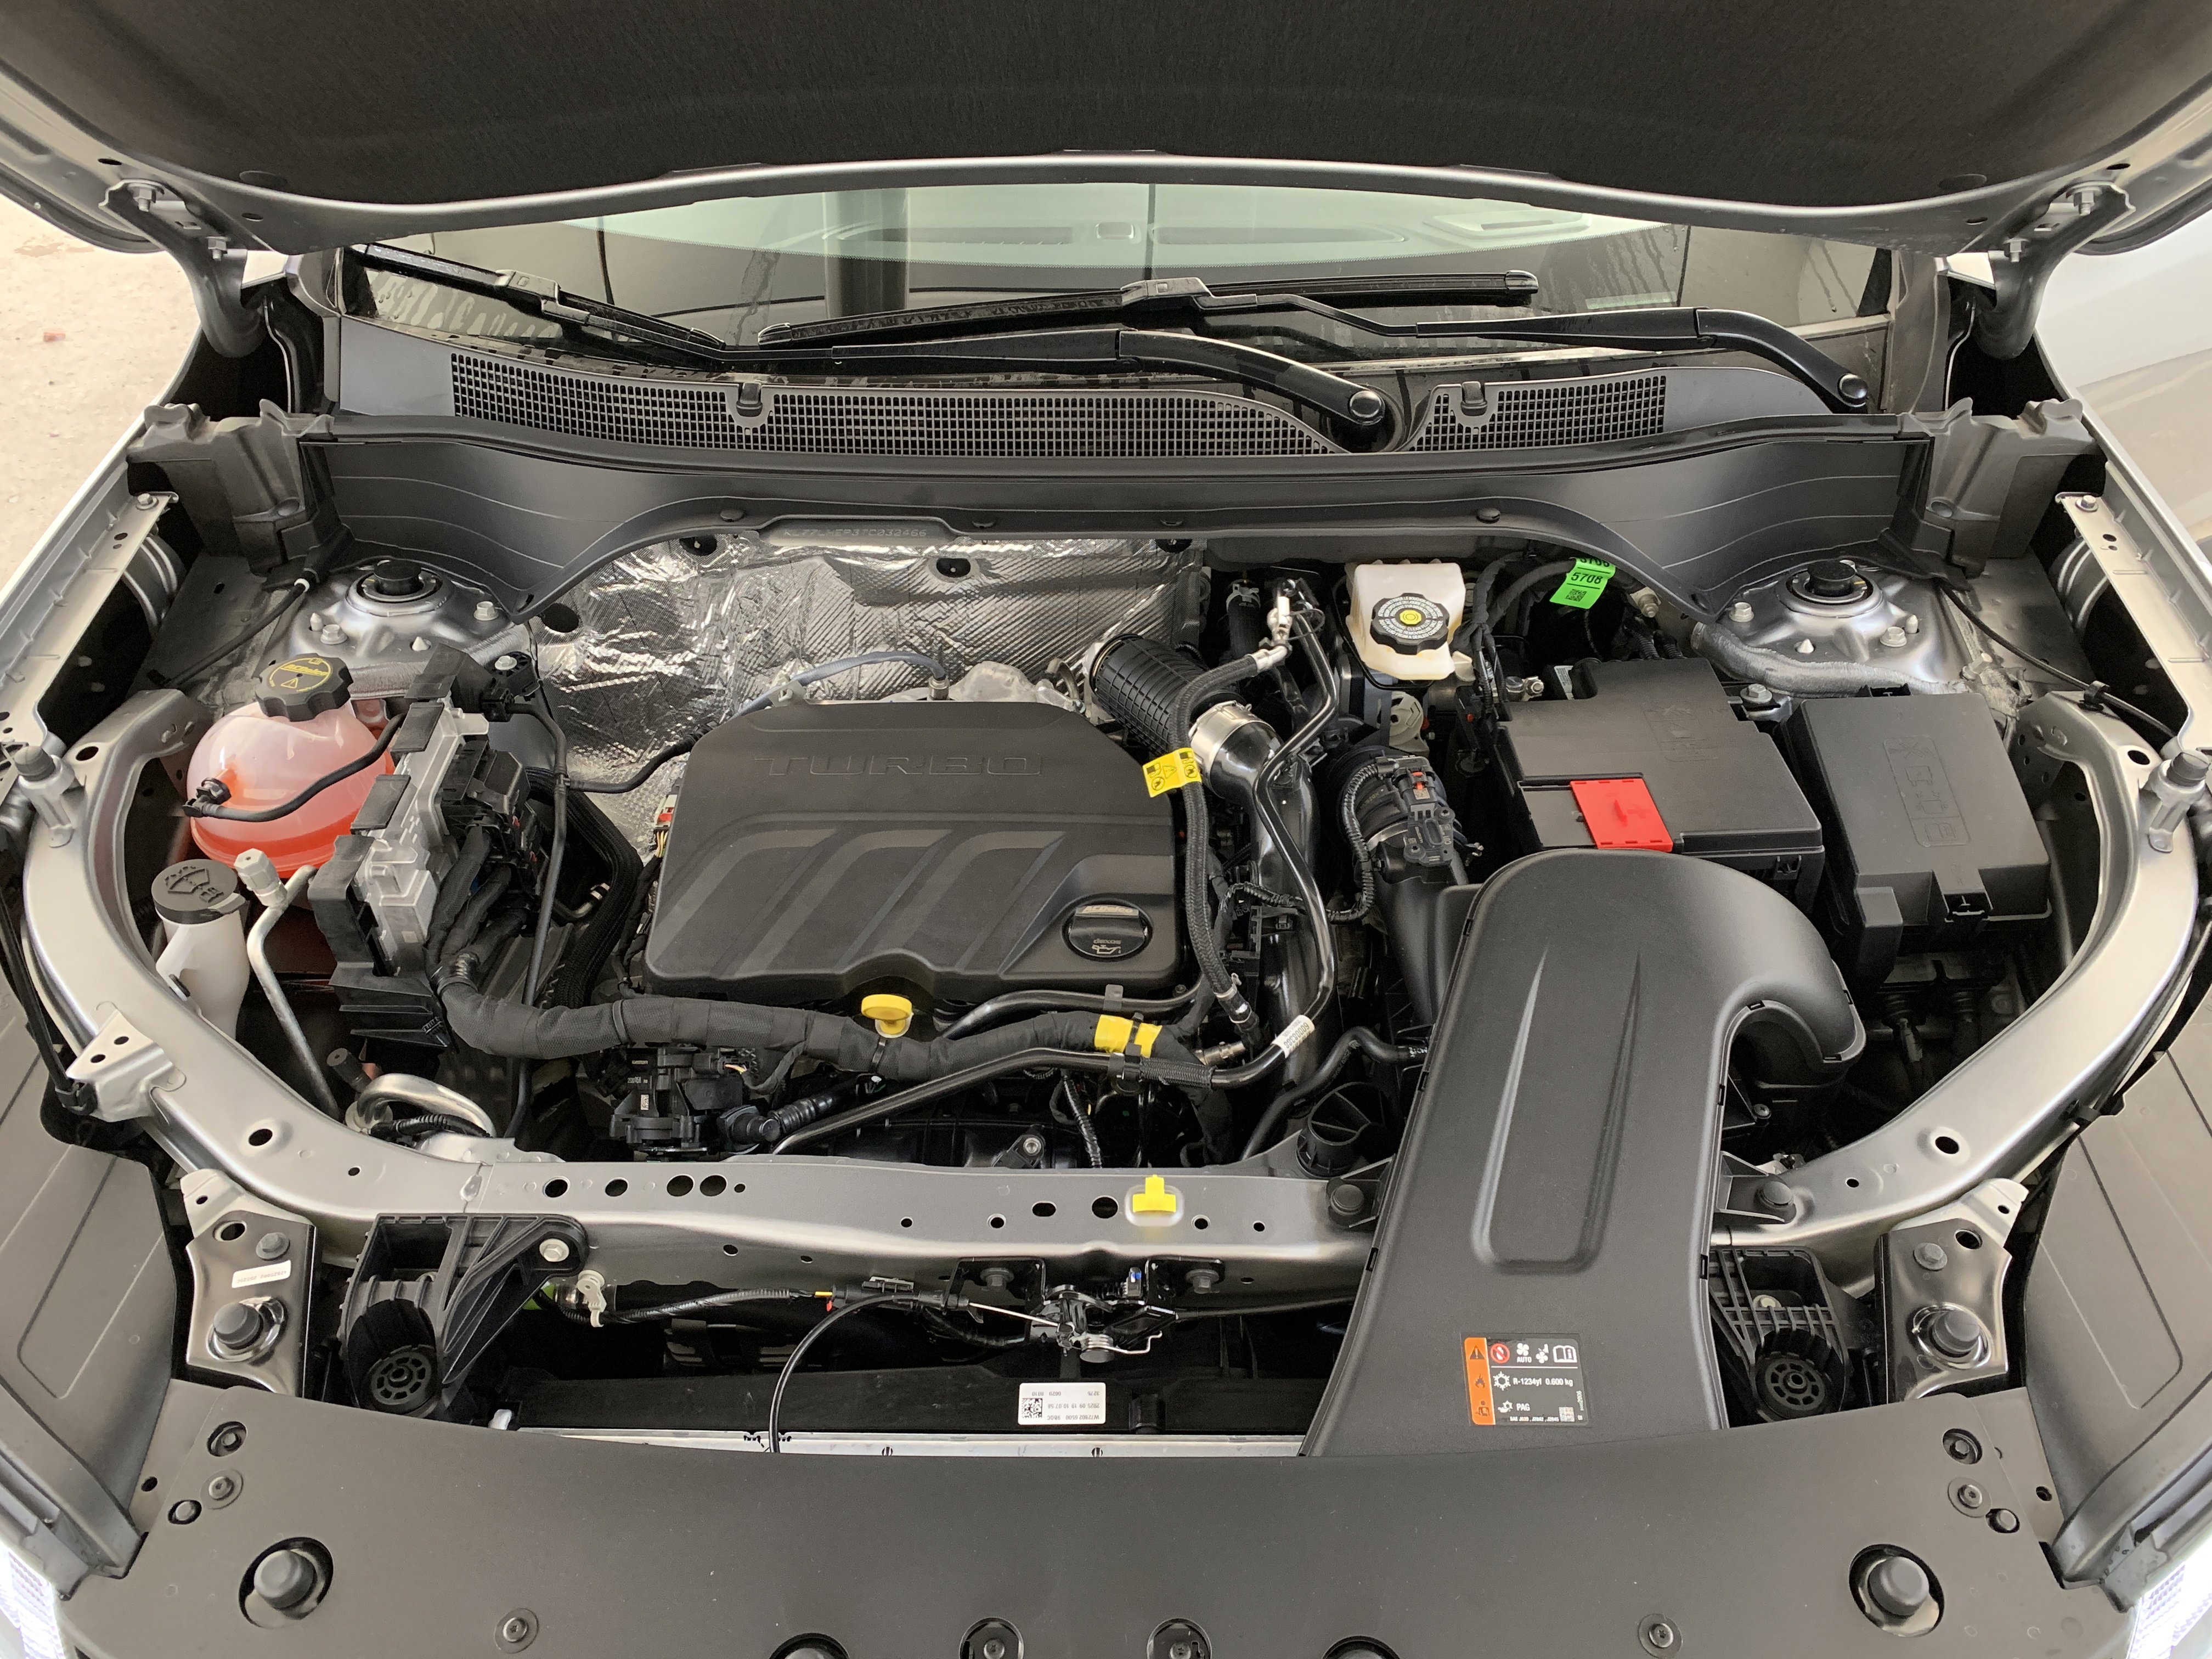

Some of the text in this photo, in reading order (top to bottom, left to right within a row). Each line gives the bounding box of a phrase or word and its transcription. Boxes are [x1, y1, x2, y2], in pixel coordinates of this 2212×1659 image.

[1571, 572, 1602, 584] 5708
[1385, 627, 1396, 635] FLUID
[754, 755, 1042, 776] TURBO
[1081, 905, 1133, 914] ACDelco
[1513, 1378, 1542, 1386] R-1234yf
[1565, 1378, 1573, 1387] kg
[1516, 1403, 1531, 1412] PAG
